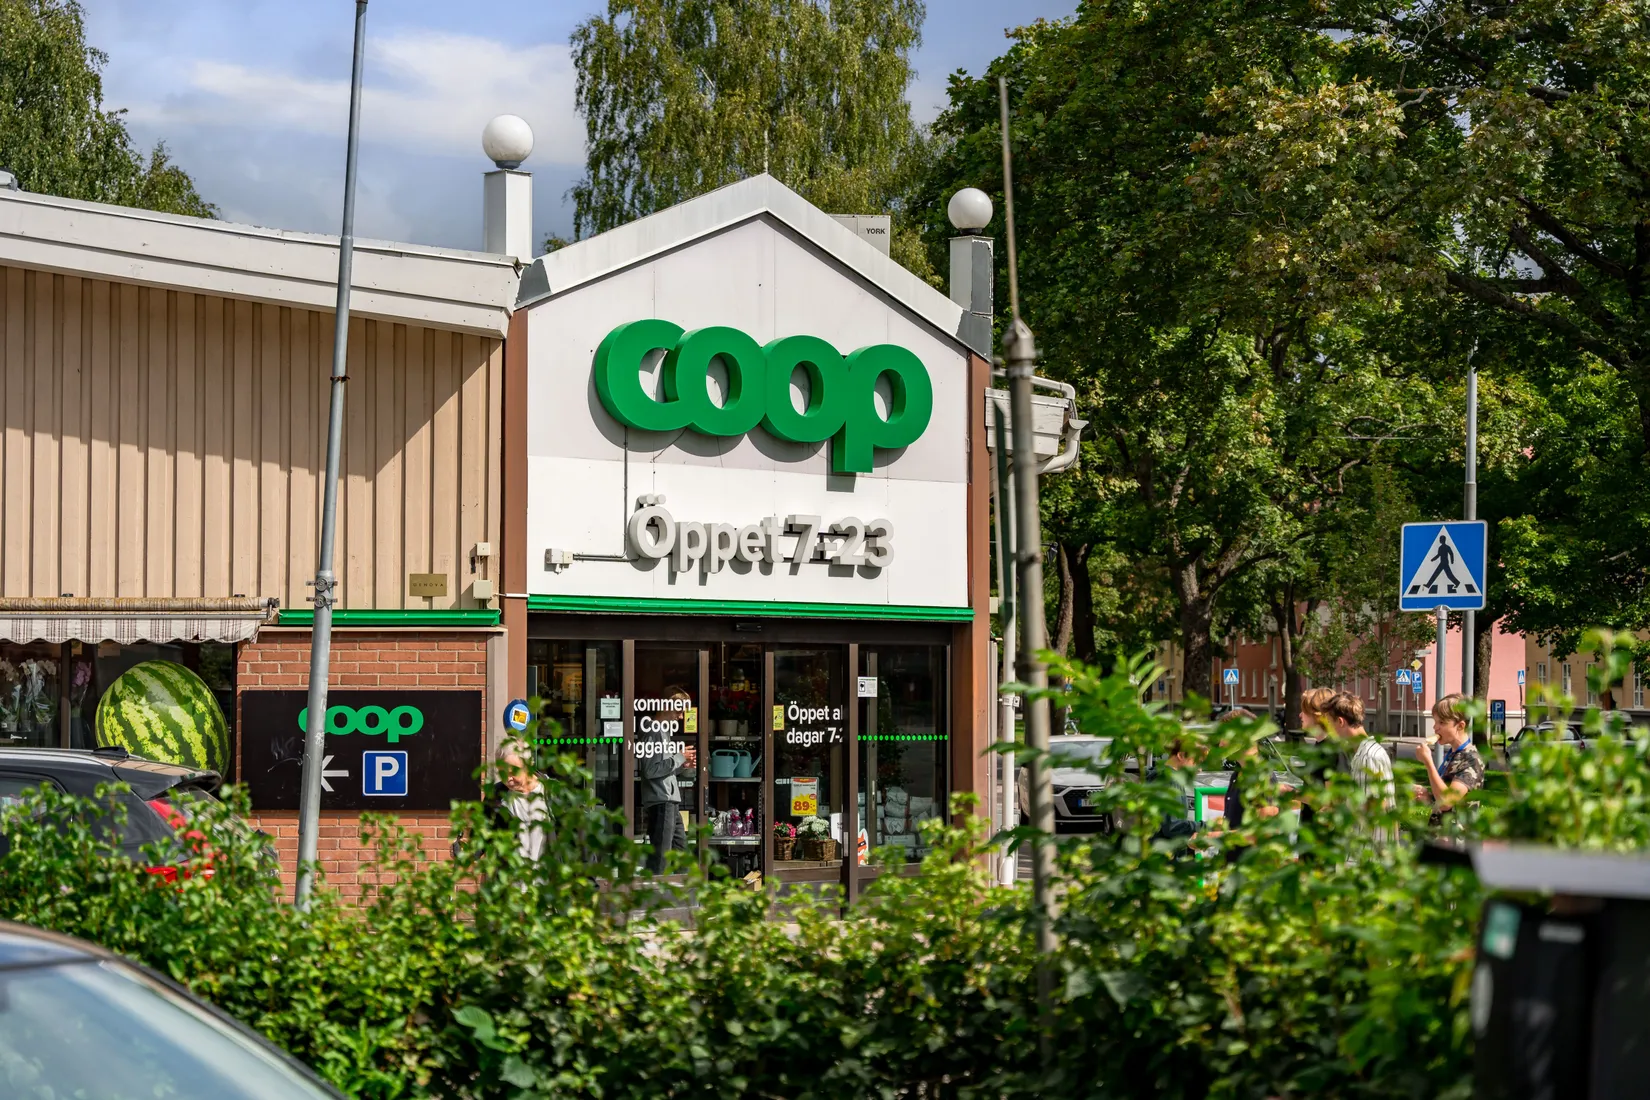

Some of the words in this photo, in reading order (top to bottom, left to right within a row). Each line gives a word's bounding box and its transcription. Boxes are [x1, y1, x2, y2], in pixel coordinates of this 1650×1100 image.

[866, 227, 886, 235] YORK
[594, 318, 934, 474] coop
[627, 493, 785, 573] Öppet
[787, 513, 895, 568] 7-23
[787, 700, 830, 724] Öppet
[640, 715, 679, 737] Coop
[786, 727, 825, 748] dagar
[633, 739, 686, 759] ggatan
[375, 756, 400, 791] P
